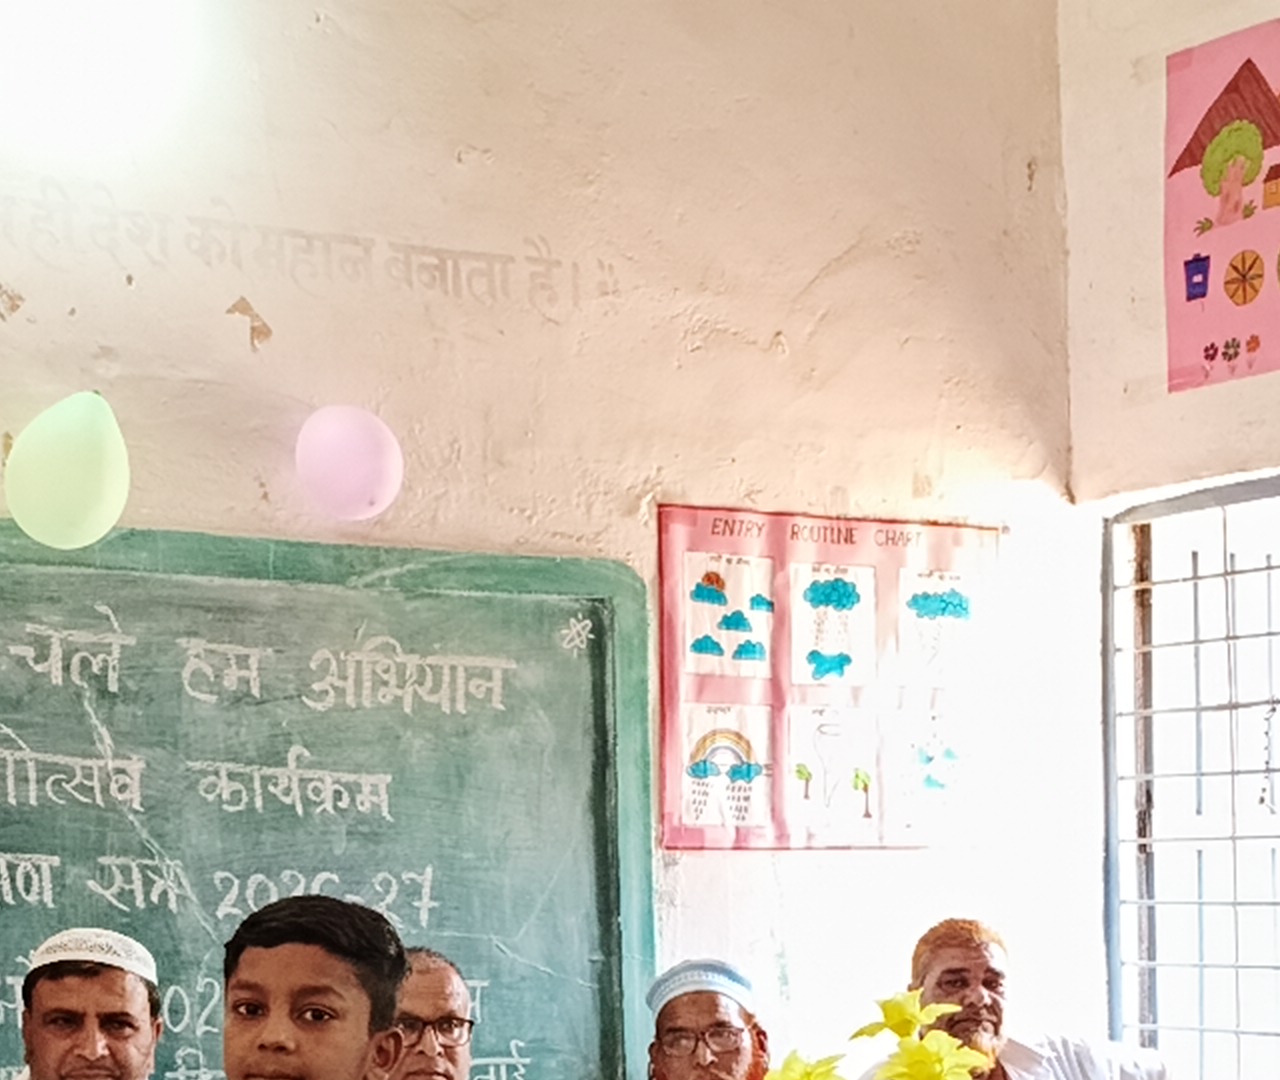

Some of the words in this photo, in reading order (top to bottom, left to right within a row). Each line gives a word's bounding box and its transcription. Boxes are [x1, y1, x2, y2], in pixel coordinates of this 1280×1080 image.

[18, 175, 78, 270] ही
[84, 183, 172, 271] देश
[181, 194, 251, 272] को
[254, 225, 376, 299] महान
[383, 236, 514, 306] बनाता
[711, 517, 766, 539] ENTRY
[790, 523, 858, 546] ROUTINE
[874, 528, 923, 548] CHART
[8, 603, 137, 693] चले
[175, 636, 273, 704] हम
[301, 634, 518, 717] अभियान
[185, 744, 395, 823] कार्यक्रम
